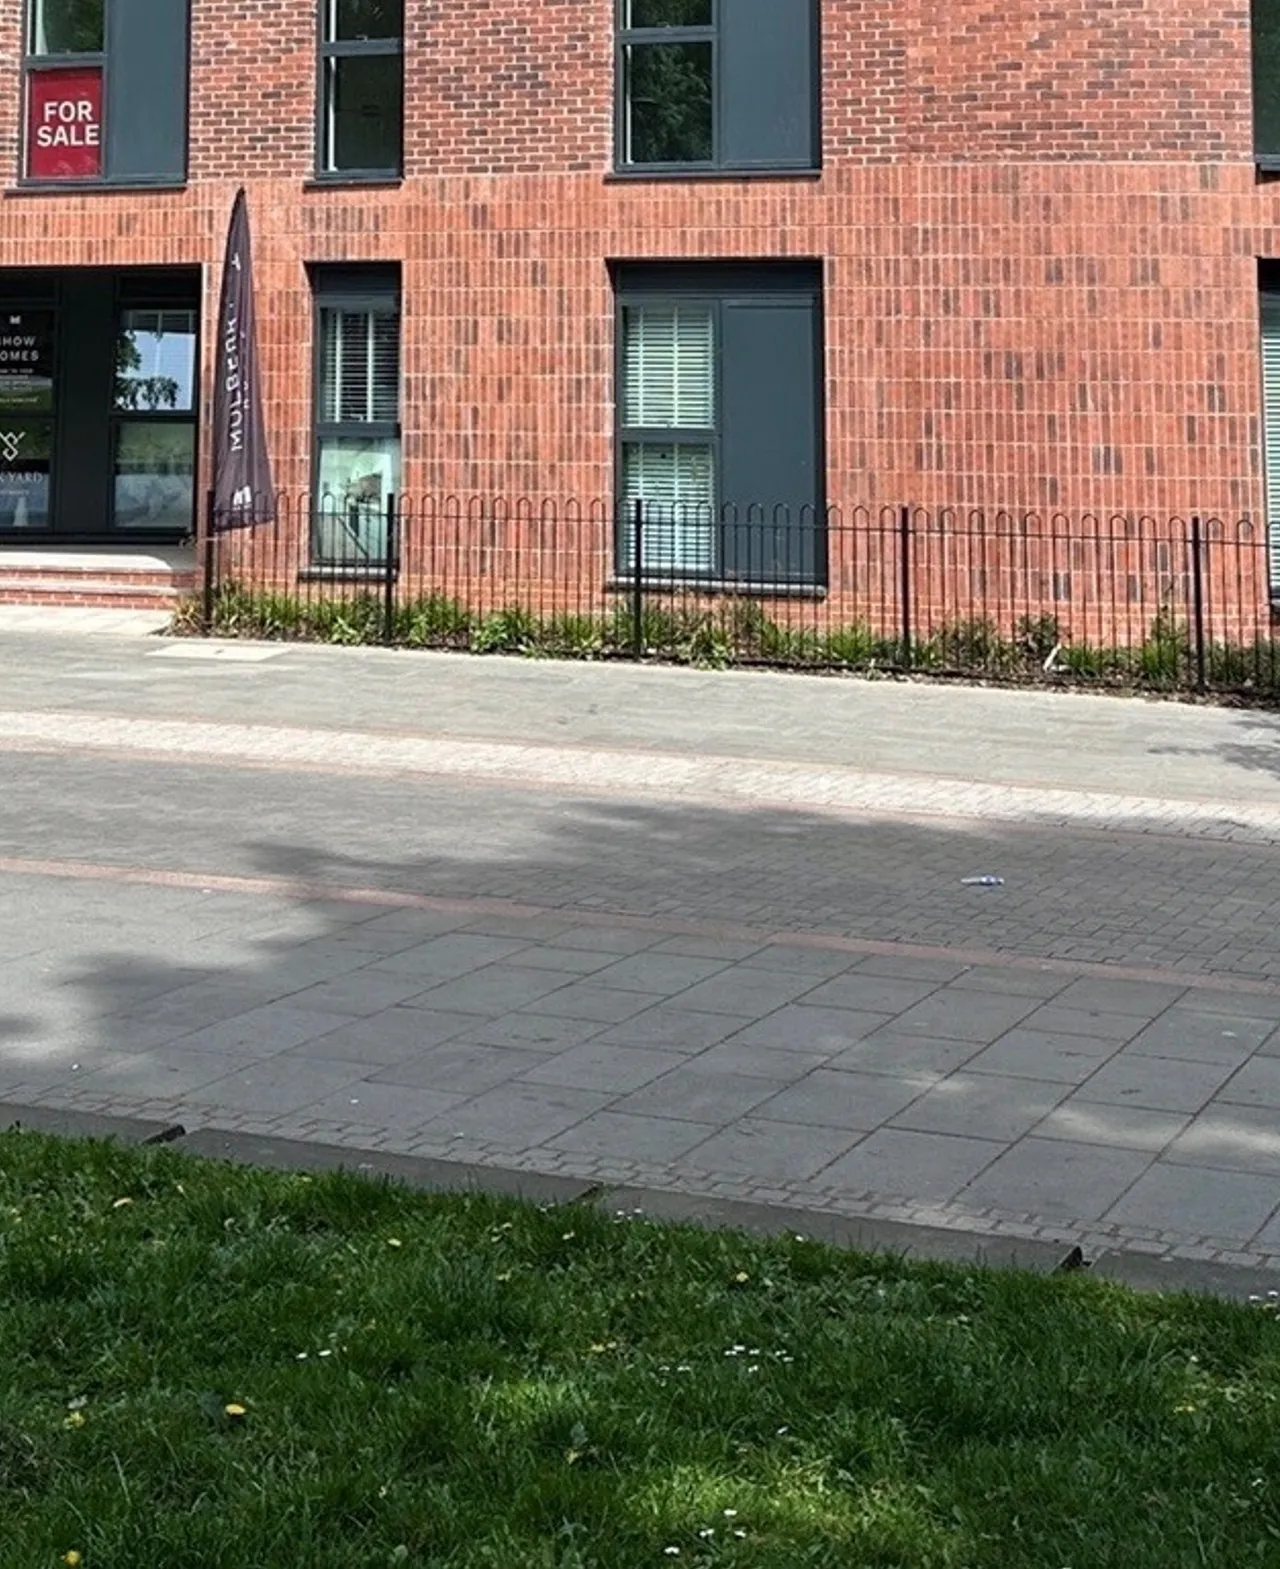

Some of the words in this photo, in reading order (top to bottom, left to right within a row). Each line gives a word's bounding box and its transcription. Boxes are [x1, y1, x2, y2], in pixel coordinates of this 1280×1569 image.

[43, 100, 93, 123] FOR
[37, 124, 100, 147] SALE
[225, 303, 243, 452] MULBERR
[7, 471, 43, 484] YARD
